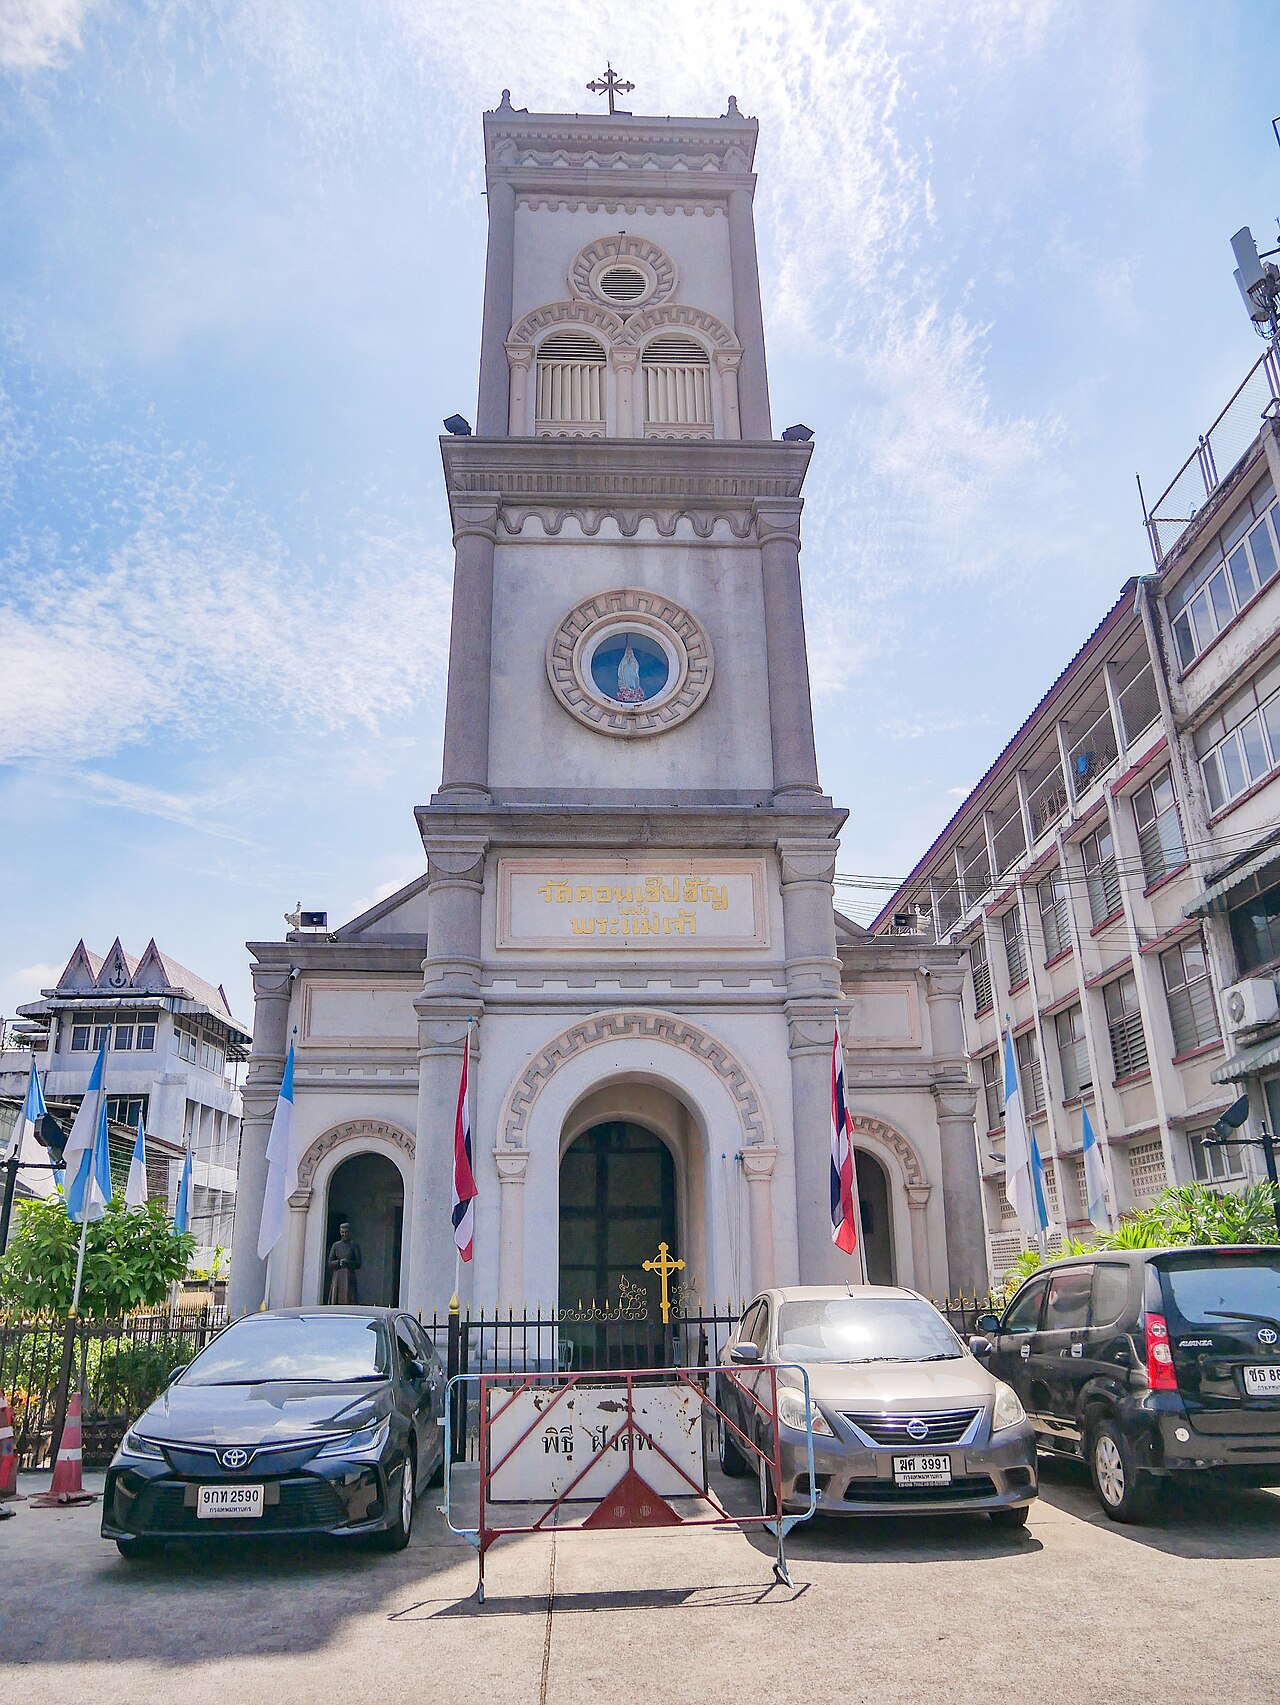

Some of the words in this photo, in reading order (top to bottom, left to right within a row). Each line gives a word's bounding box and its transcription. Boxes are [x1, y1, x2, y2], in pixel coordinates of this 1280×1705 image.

[570, 907, 696, 934] พระแม่เจ้า
[1178, 1339, 1213, 1347] AVANZA
[541, 1424, 574, 1453] พิธี
[592, 1424, 652, 1452] ฝังศพ
[921, 1458, 948, 1470] 3991
[230, 1489, 259, 1503] 2590
